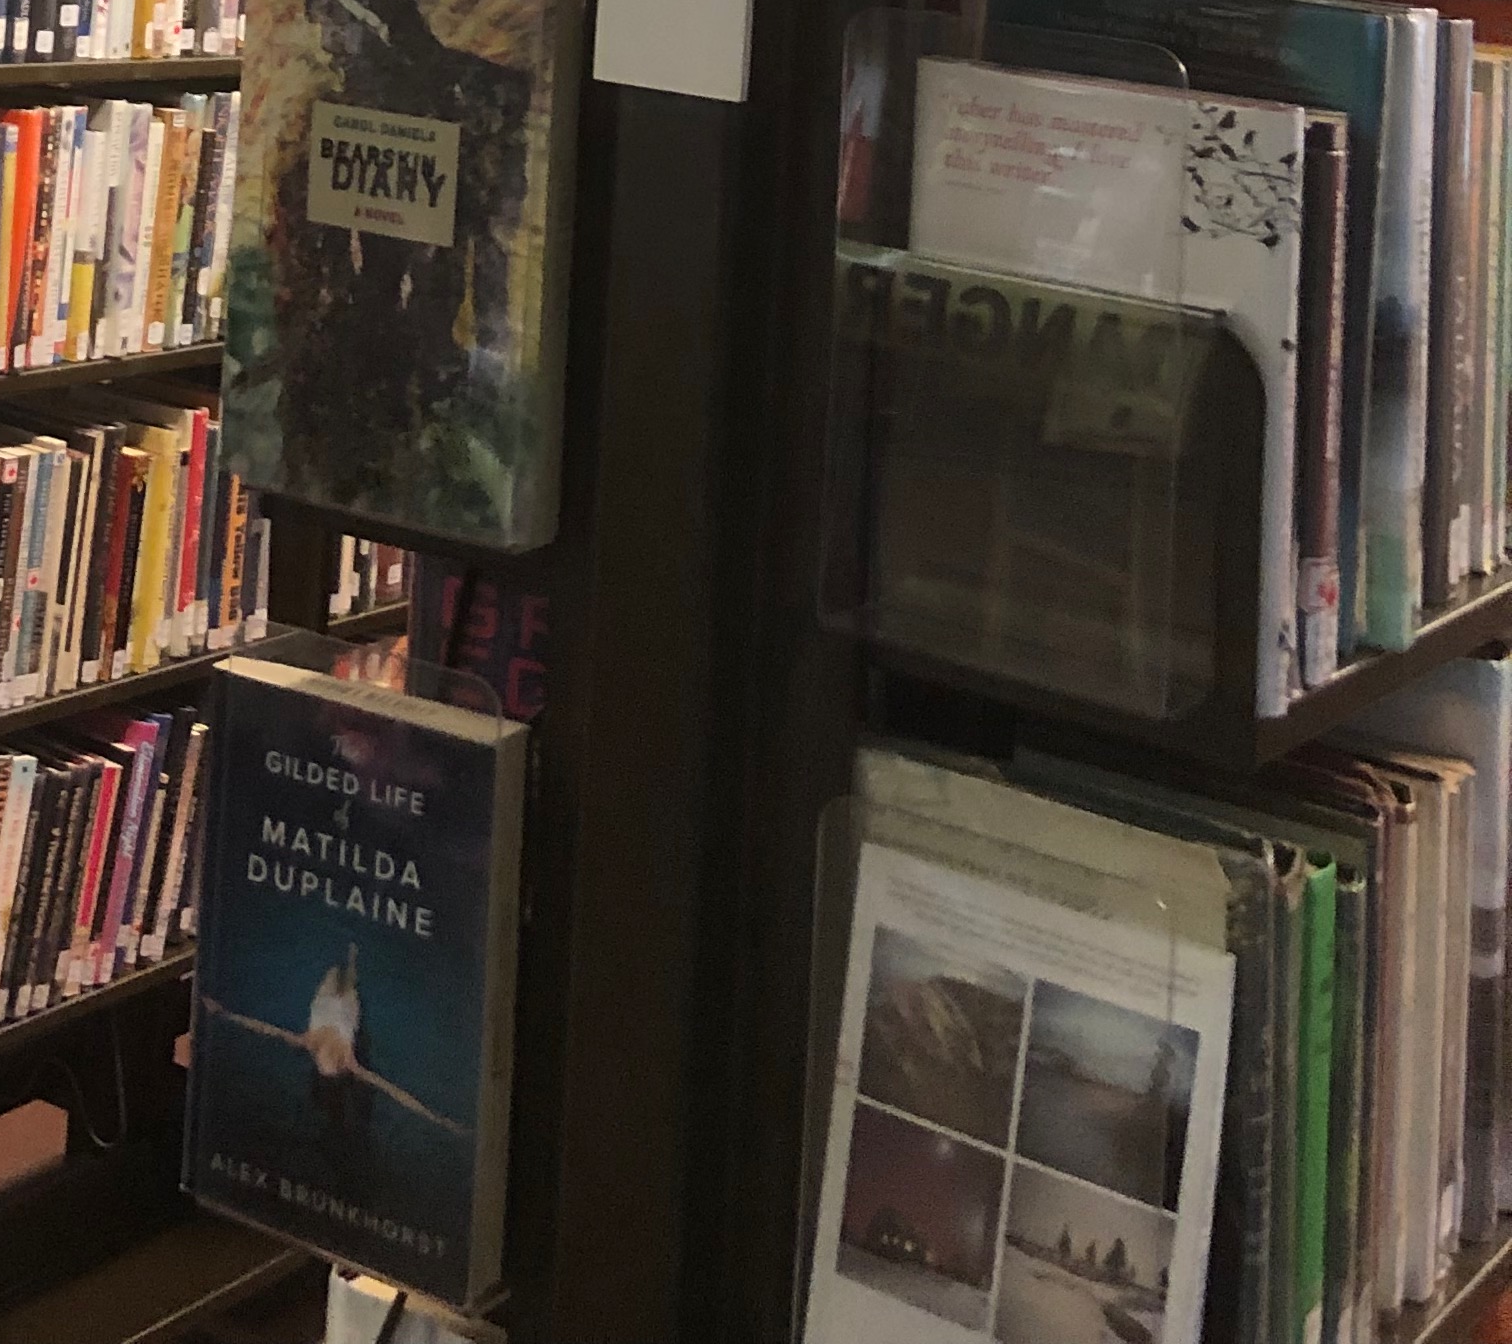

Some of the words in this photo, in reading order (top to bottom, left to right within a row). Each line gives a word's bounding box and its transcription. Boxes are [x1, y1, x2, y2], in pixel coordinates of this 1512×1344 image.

[320, 138, 438, 175] BEARSKIN
[331, 156, 446, 208] DIARY
[265, 750, 360, 796] GILDED
[369, 781, 425, 815] LIFE
[261, 815, 422, 889] MATILDA
[246, 853, 435, 939] DUPLAINE
[210, 1152, 269, 1189] ALEX
[278, 1174, 447, 1259] BRUNKHORST
